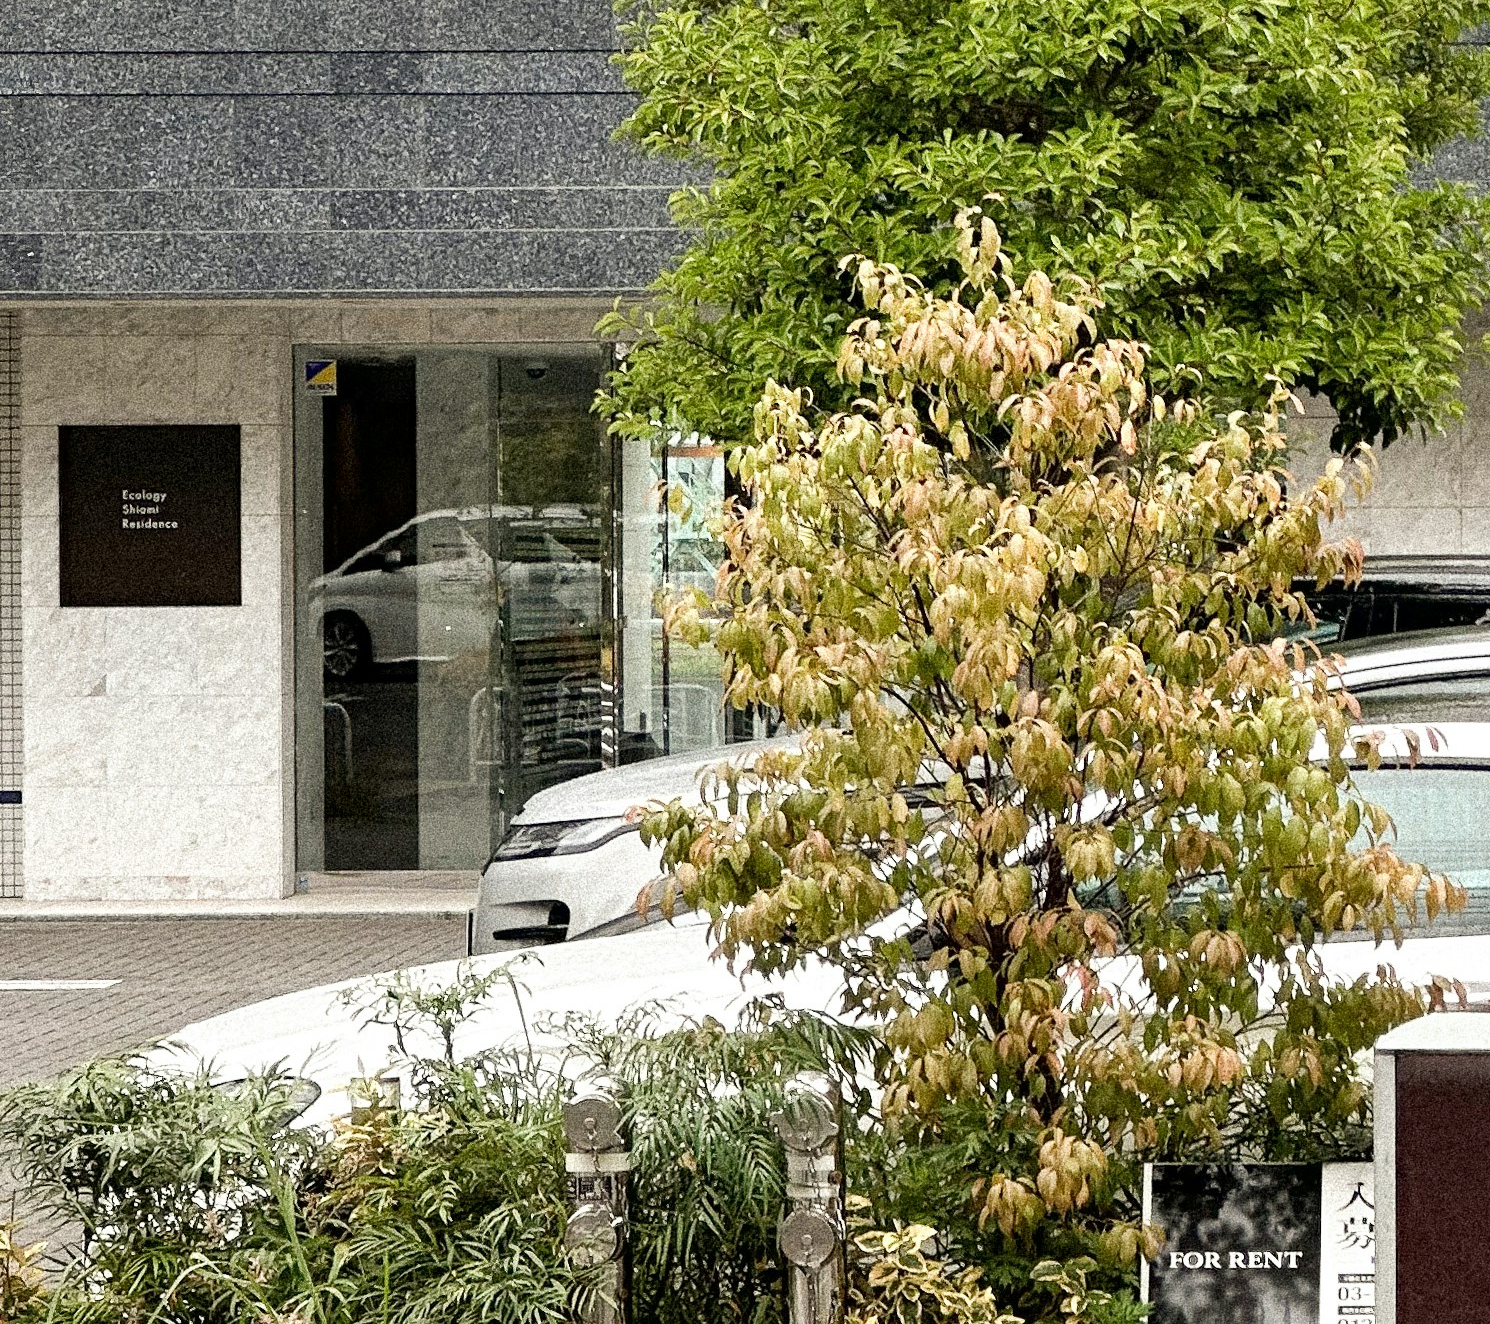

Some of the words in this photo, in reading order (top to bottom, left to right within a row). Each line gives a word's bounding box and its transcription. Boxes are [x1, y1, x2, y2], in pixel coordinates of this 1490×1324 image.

[122, 489, 167, 503] Ecology
[122, 518, 179, 529] Residence
[1169, 1252, 1221, 1269] FOR
[1229, 1251, 1303, 1269] RENT
